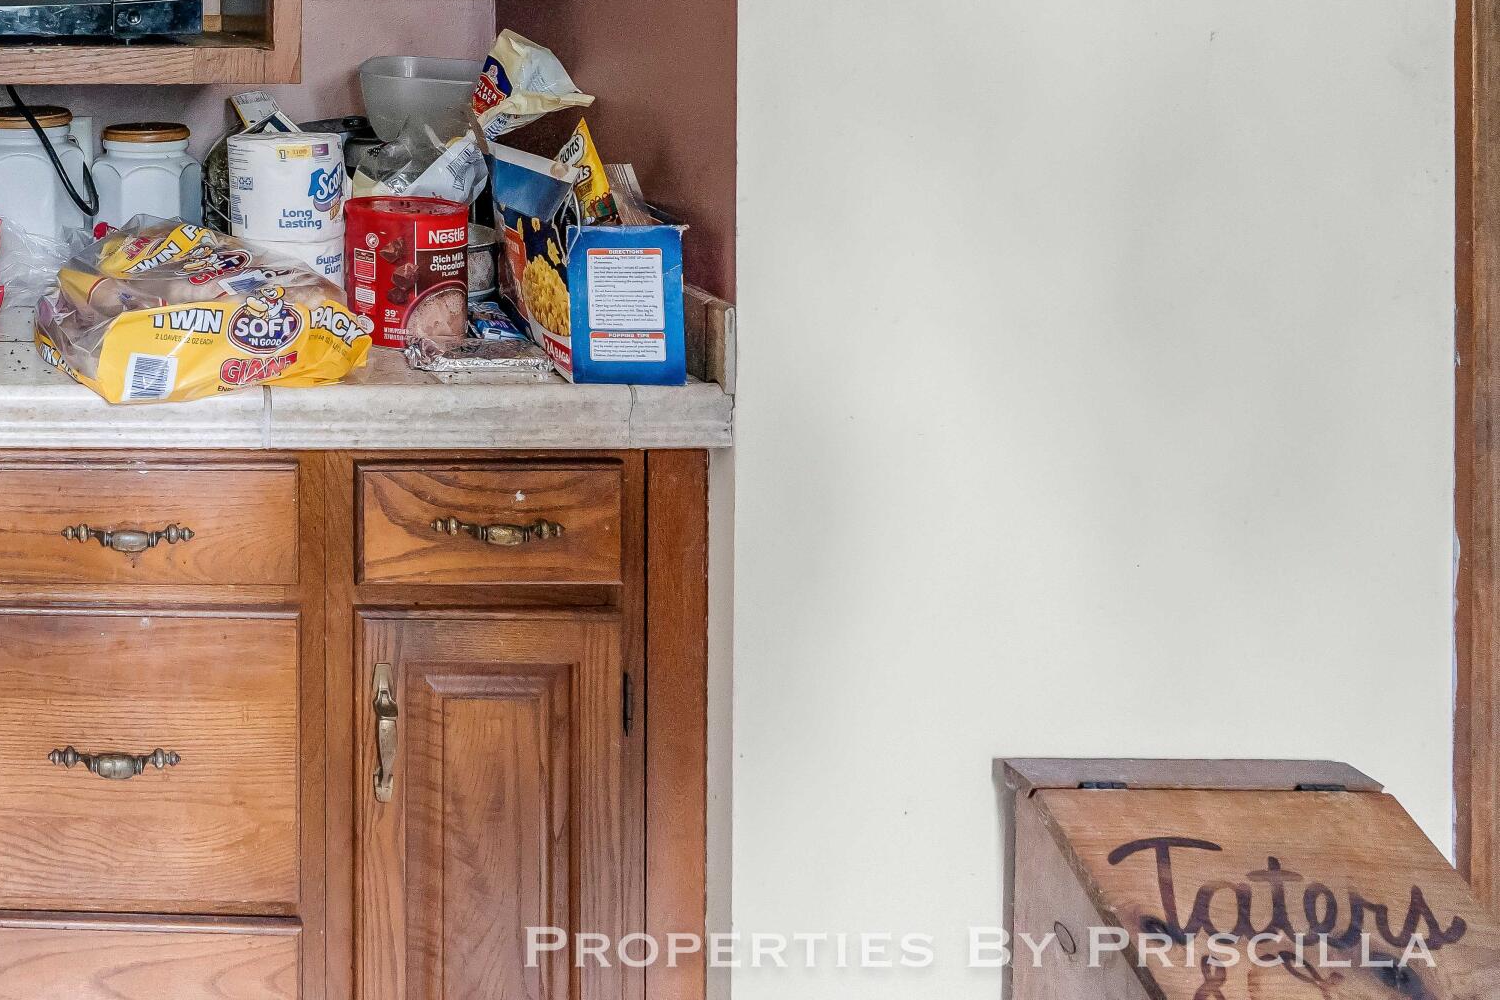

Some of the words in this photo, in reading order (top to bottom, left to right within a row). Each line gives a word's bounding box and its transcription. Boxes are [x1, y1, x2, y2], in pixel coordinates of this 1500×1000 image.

[283, 208, 313, 219] Long
[279, 219, 322, 230] Lasting
[432, 255, 450, 263] Rich
[430, 261, 465, 271] Chocolate
[148, 308, 223, 334] TWIN
[309, 306, 368, 348] PACK
[235, 317, 295, 338] SOFT
[160, 334, 182, 342] LOAVES
[260, 338, 282, 346] GOOD
[555, 350, 570, 365] BAGS
[1107, 836, 1467, 950] Taters
